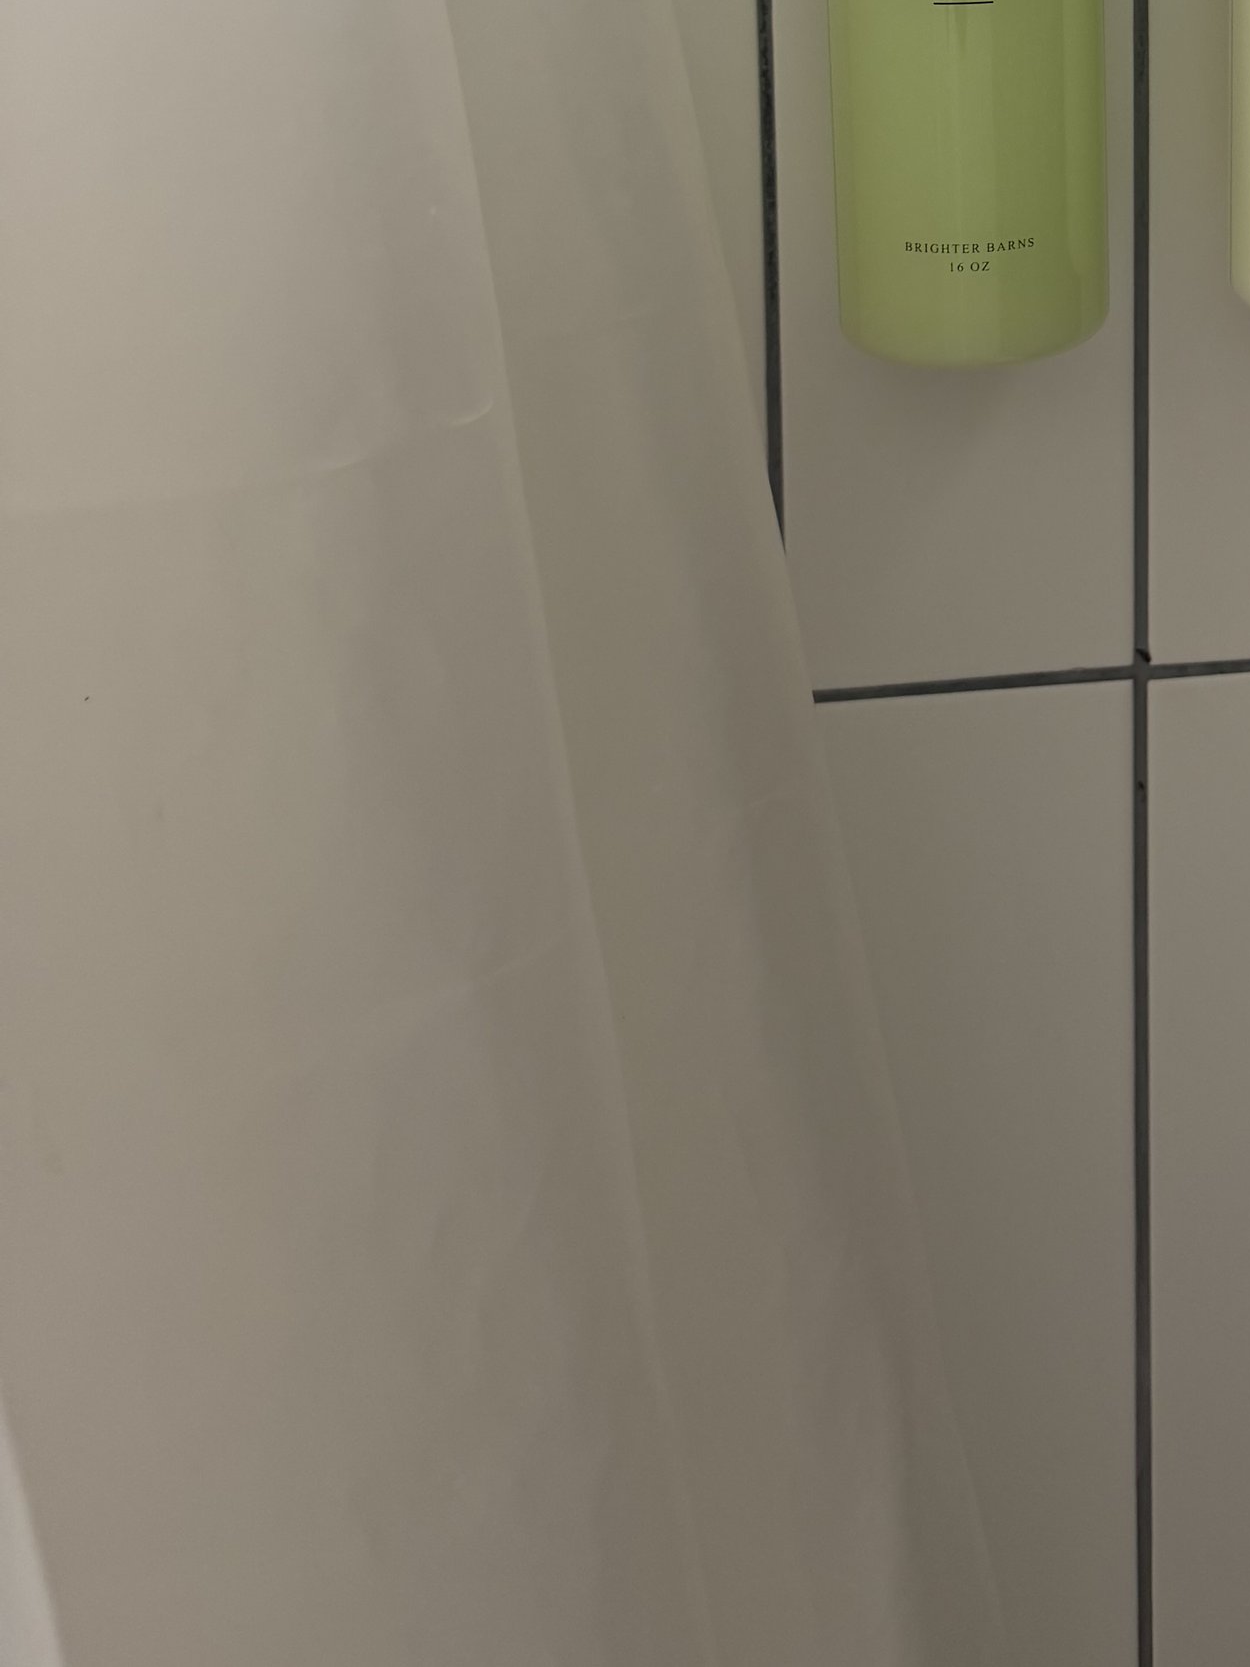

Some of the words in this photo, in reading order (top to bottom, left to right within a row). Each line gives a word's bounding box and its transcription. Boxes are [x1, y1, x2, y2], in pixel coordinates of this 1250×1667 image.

[904, 240, 981, 255] BRIGHTER
[986, 237, 1036, 254] BARNS
[949, 261, 965, 274] 16
[970, 260, 991, 273] OZ
